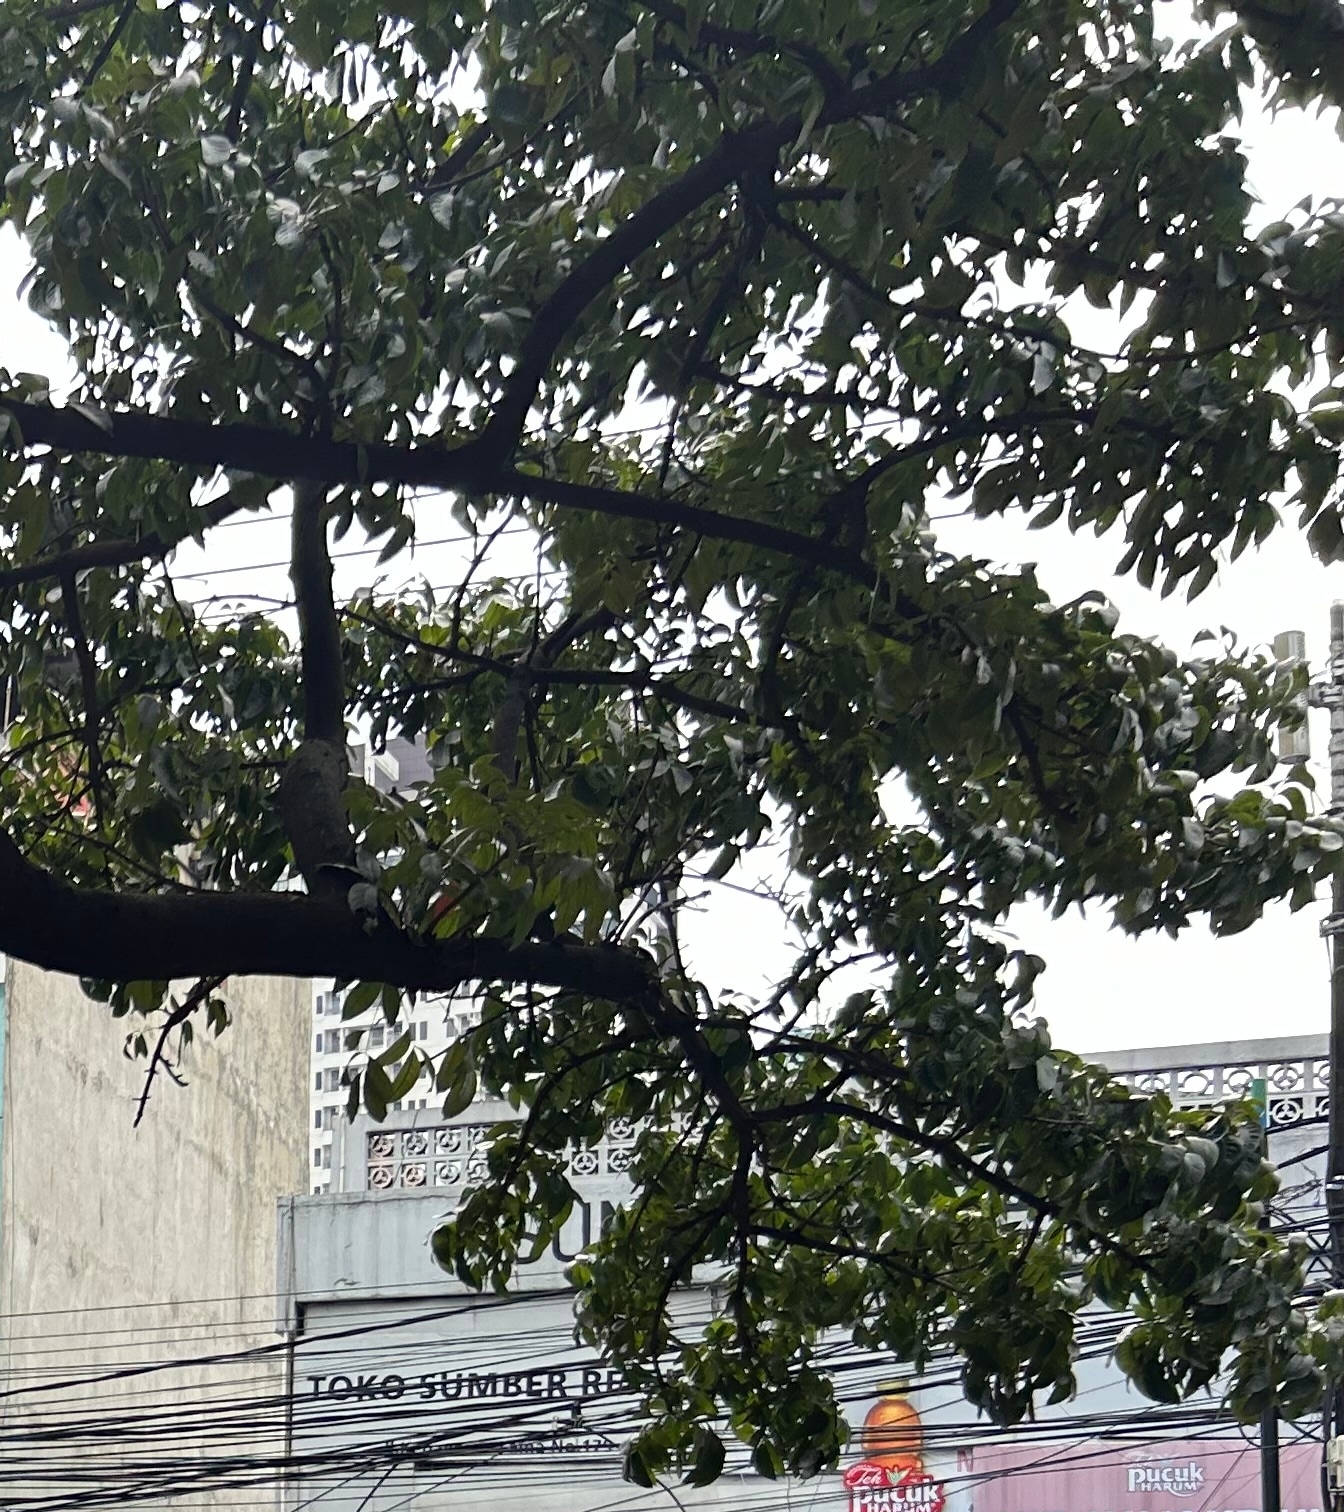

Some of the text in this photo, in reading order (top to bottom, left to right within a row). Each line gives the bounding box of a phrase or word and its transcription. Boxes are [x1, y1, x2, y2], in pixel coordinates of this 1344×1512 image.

[307, 1374, 405, 1400] TOKO
[419, 1371, 567, 1399] SUMBER
[846, 1465, 883, 1486] Teh
